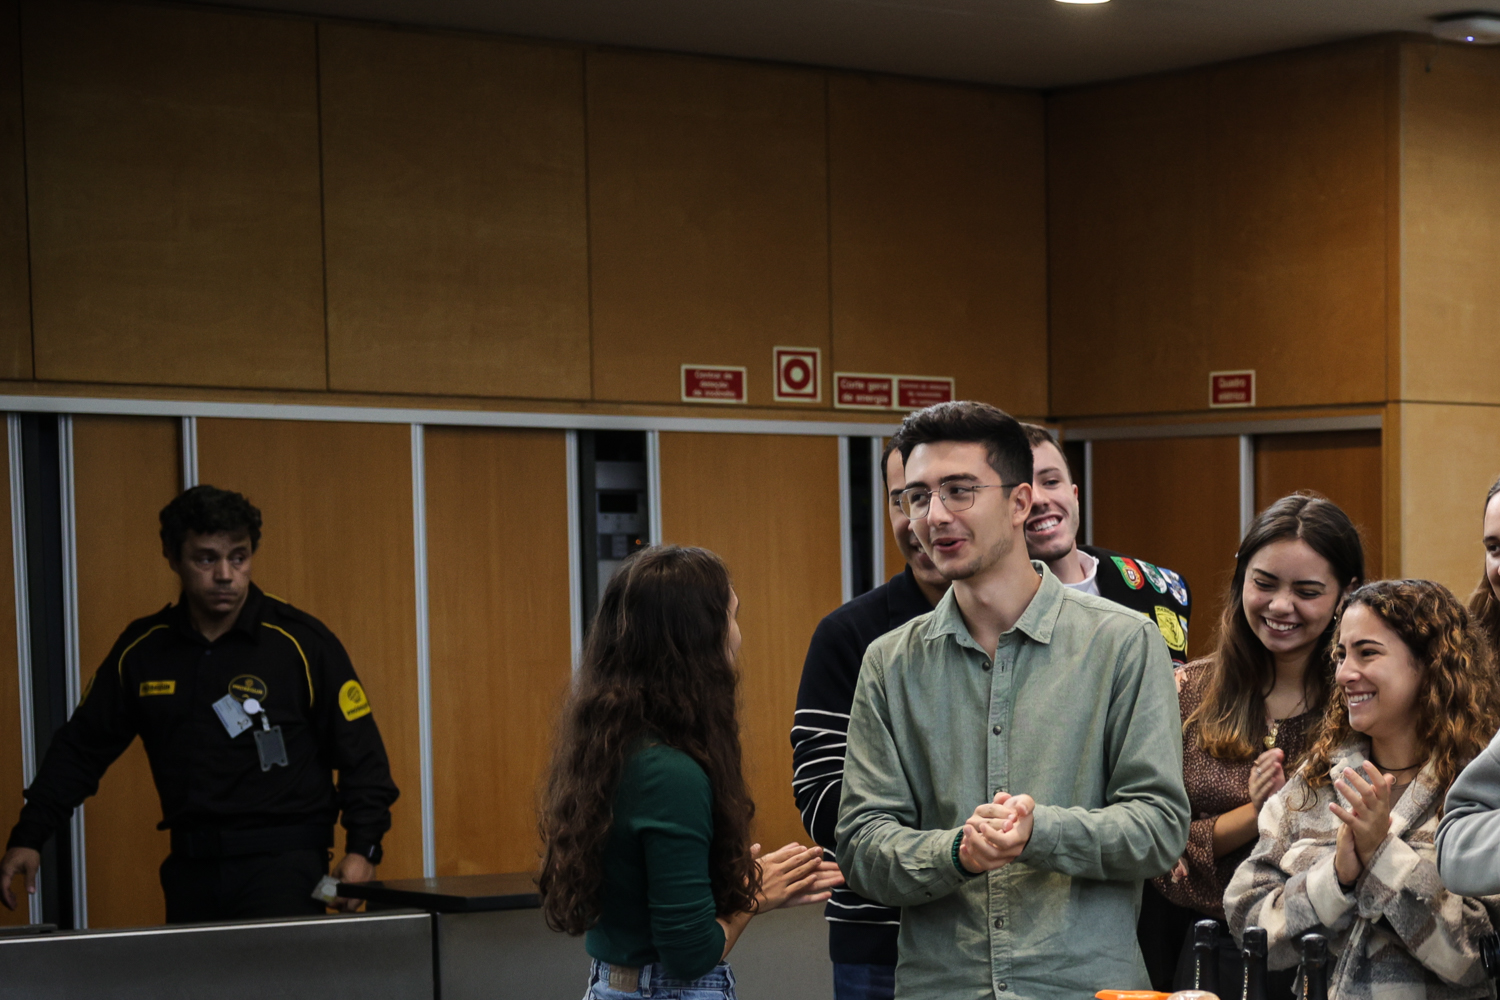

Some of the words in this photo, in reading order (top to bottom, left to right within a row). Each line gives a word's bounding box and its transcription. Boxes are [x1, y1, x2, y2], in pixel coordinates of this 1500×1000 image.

[840, 378, 865, 390] Corte
[867, 381, 889, 392] geral
[856, 393, 889, 405] energia
